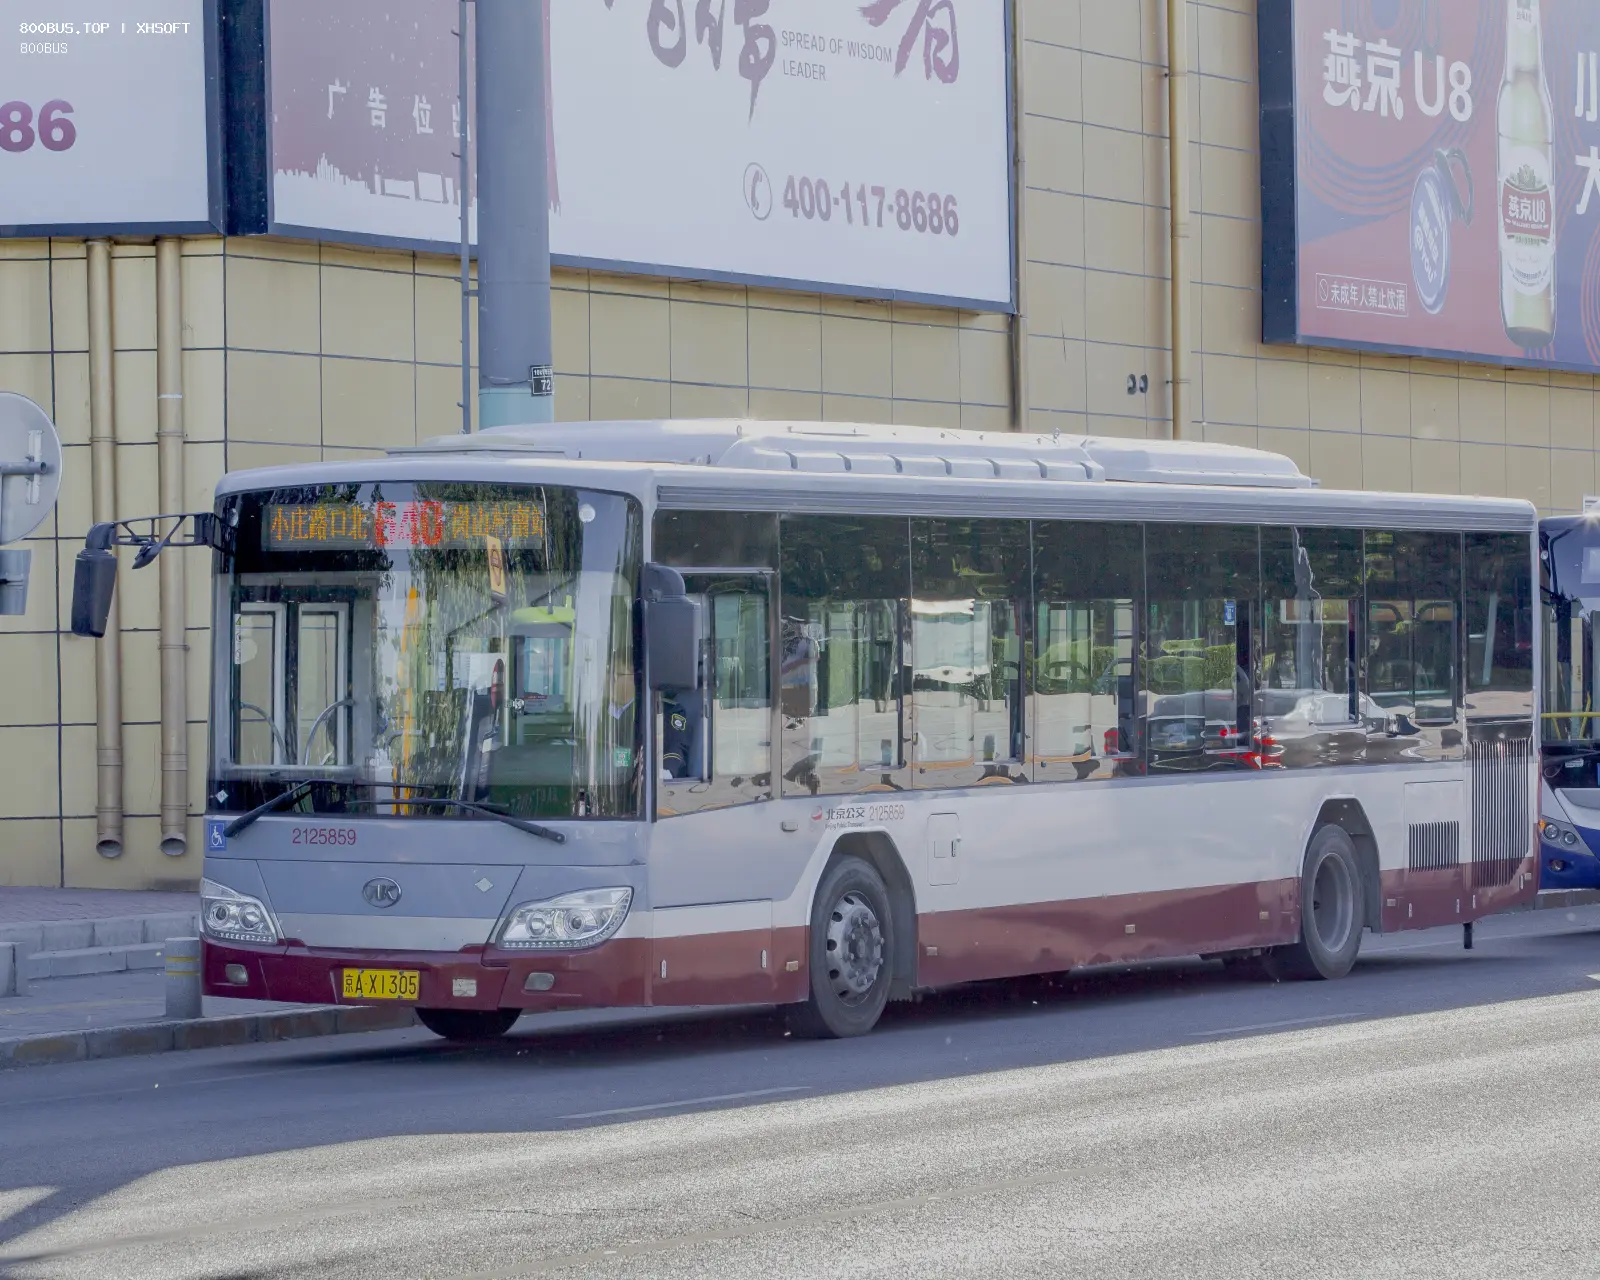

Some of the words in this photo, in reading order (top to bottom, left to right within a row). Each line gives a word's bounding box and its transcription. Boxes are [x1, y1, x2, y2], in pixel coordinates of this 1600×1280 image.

[781, 30, 826, 52] SPREAD
[829, 38, 844, 54] OF
[847, 41, 892, 63] WISDOM
[782, 59, 827, 81] LEADER
[0, 99, 77, 153] 86
[1330, 281, 1405, 312] 未成年人禁止饮酒
[374, 500, 444, 546] 640
[825, 807, 866, 821] 北京公交
[868, 804, 905, 821] 2125859
[292, 827, 357, 846] 2125859
